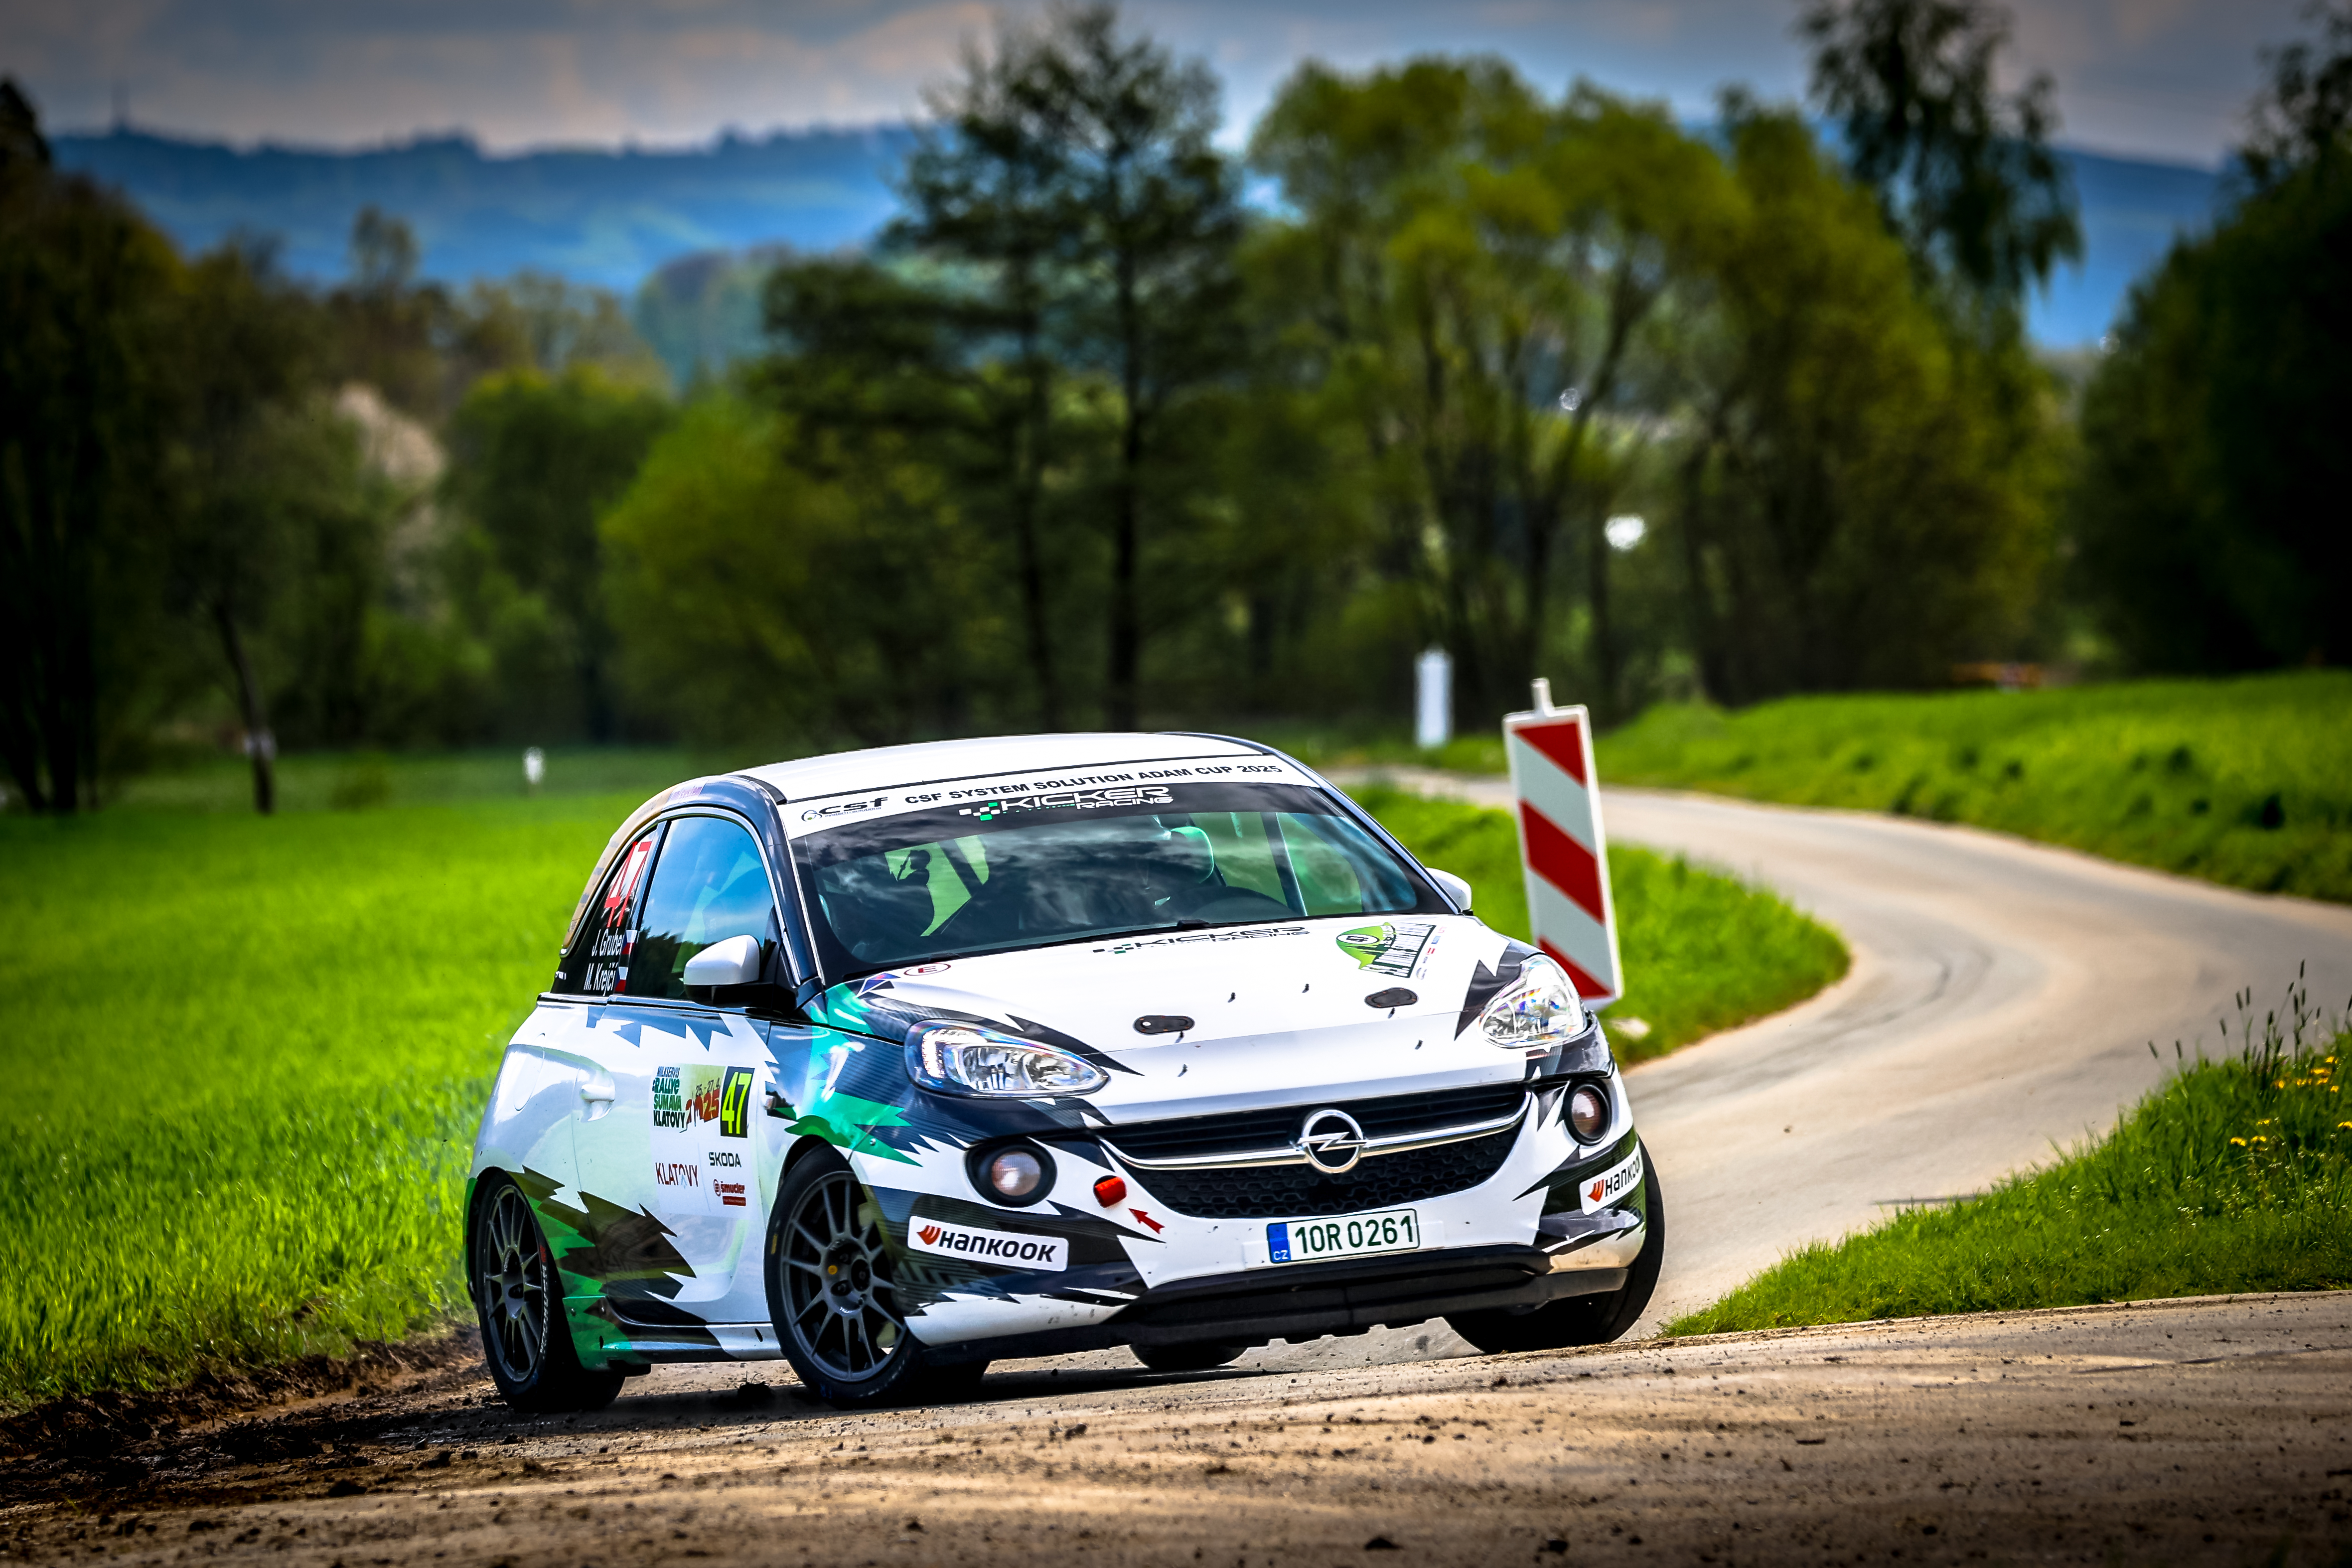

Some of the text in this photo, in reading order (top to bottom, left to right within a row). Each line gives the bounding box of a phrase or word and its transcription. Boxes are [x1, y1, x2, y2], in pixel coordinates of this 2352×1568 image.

[905, 793, 942, 804] CSF
[949, 784, 1030, 798] SYSTEM
[1033, 773, 1134, 789] SOLUTION
[1140, 769, 1193, 779] ADAM
[1001, 786, 1170, 811] KICKER
[1076, 796, 1174, 810] RACING
[604, 841, 652, 928] 47
[591, 929, 601, 956] J.
[1135, 927, 1306, 948] KICKER
[1212, 931, 1310, 942] RACING
[584, 962, 618, 997] M. Krejčí
[722, 1072, 752, 1134] 47
[653, 1110, 686, 1129] KLATOVY
[655, 1162, 699, 1187] KLATOVY
[1295, 1215, 1413, 1254] 10R 0261
[1273, 1250, 1288, 1261] CZ
